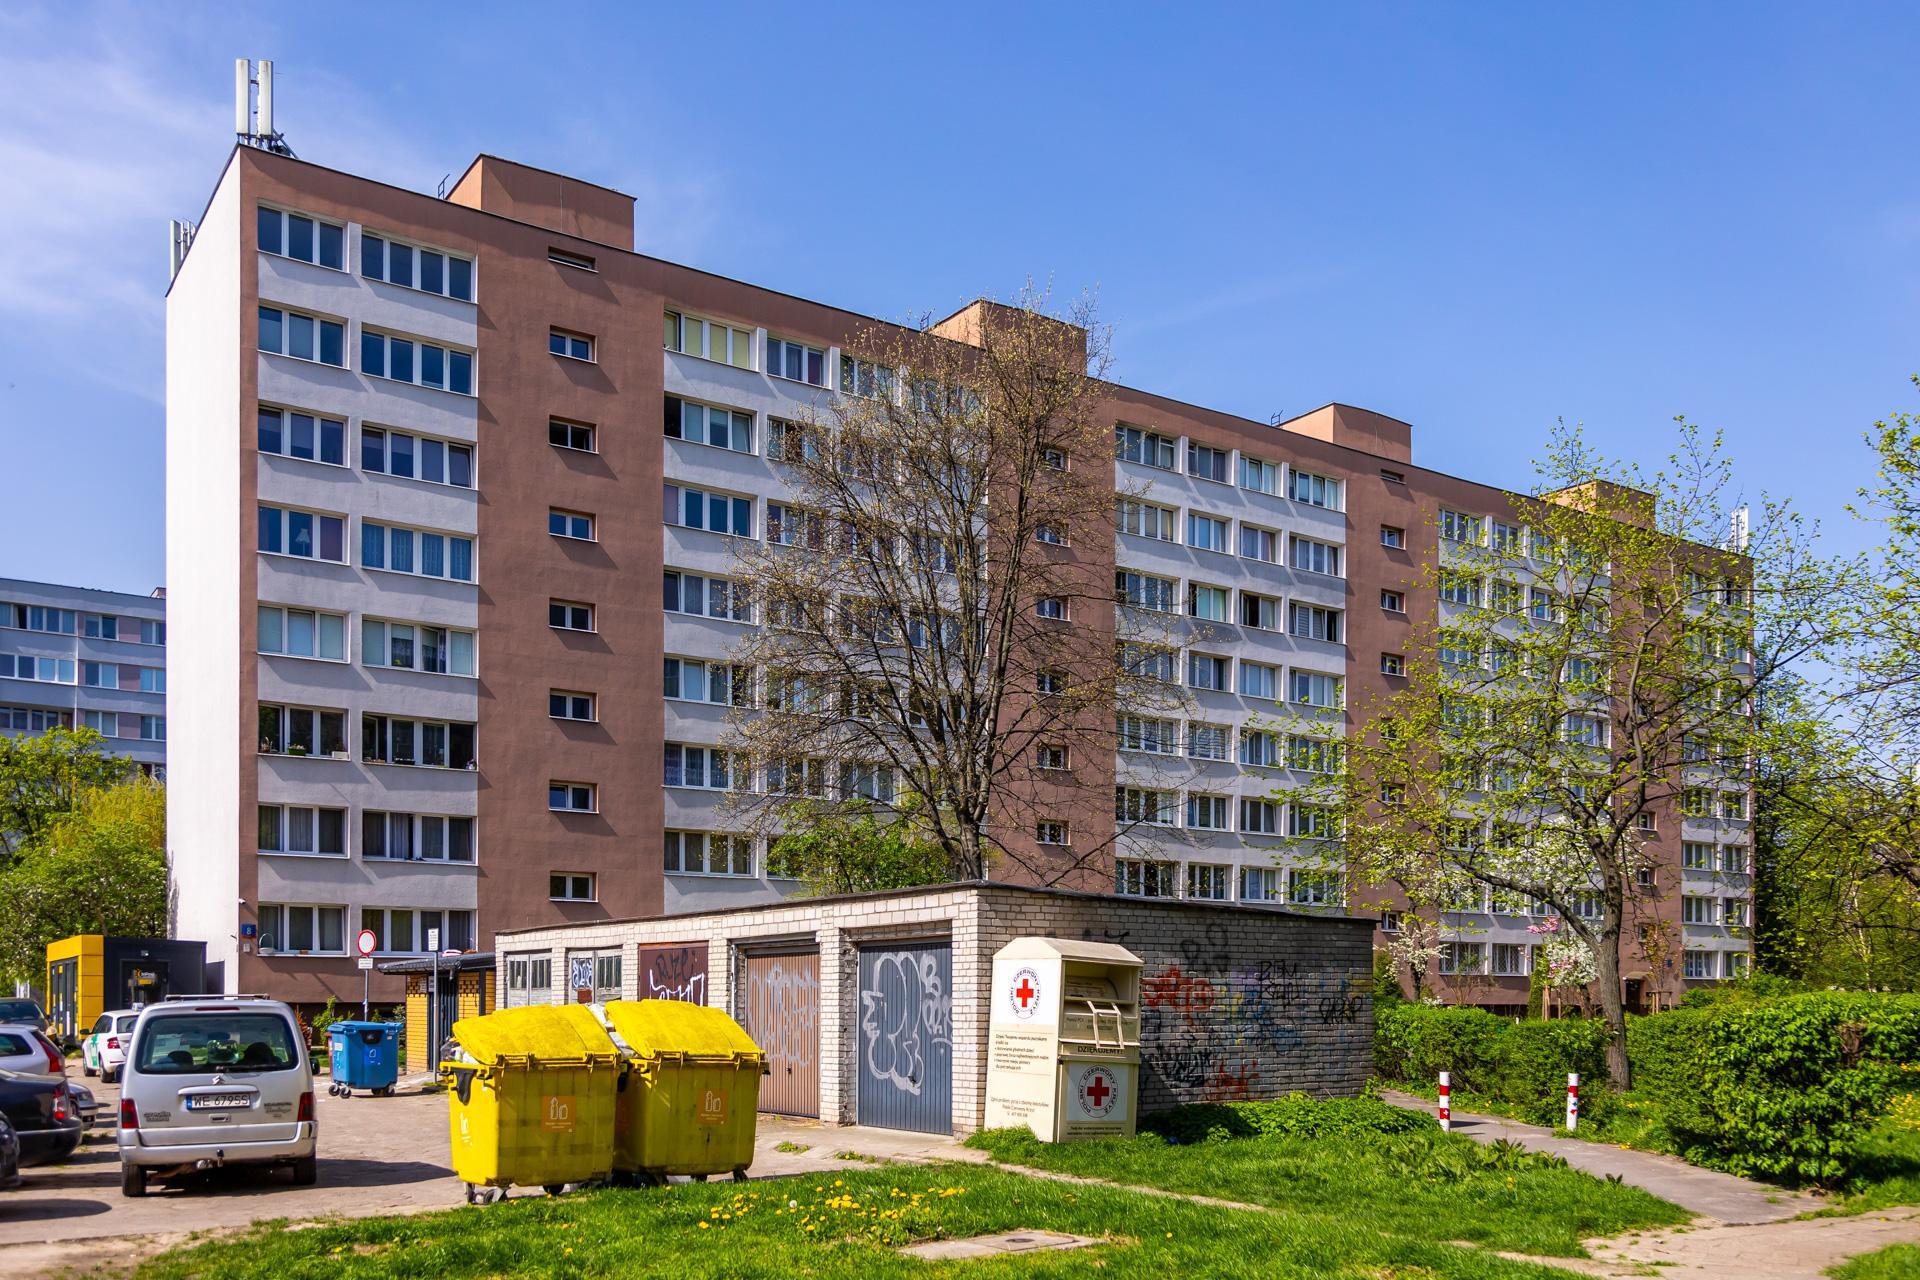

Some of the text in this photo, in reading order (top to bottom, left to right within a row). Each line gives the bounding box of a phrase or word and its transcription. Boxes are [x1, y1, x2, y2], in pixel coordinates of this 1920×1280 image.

[246, 926, 252, 935] 8
[1013, 969, 1040, 986] CZERWONY
[1010, 986, 1020, 1014] POLSKI
[1083, 1067, 1116, 1084] CZERWONY
[194, 1095, 210, 1107] WE
[1079, 1085, 1091, 1114] POLSKI
